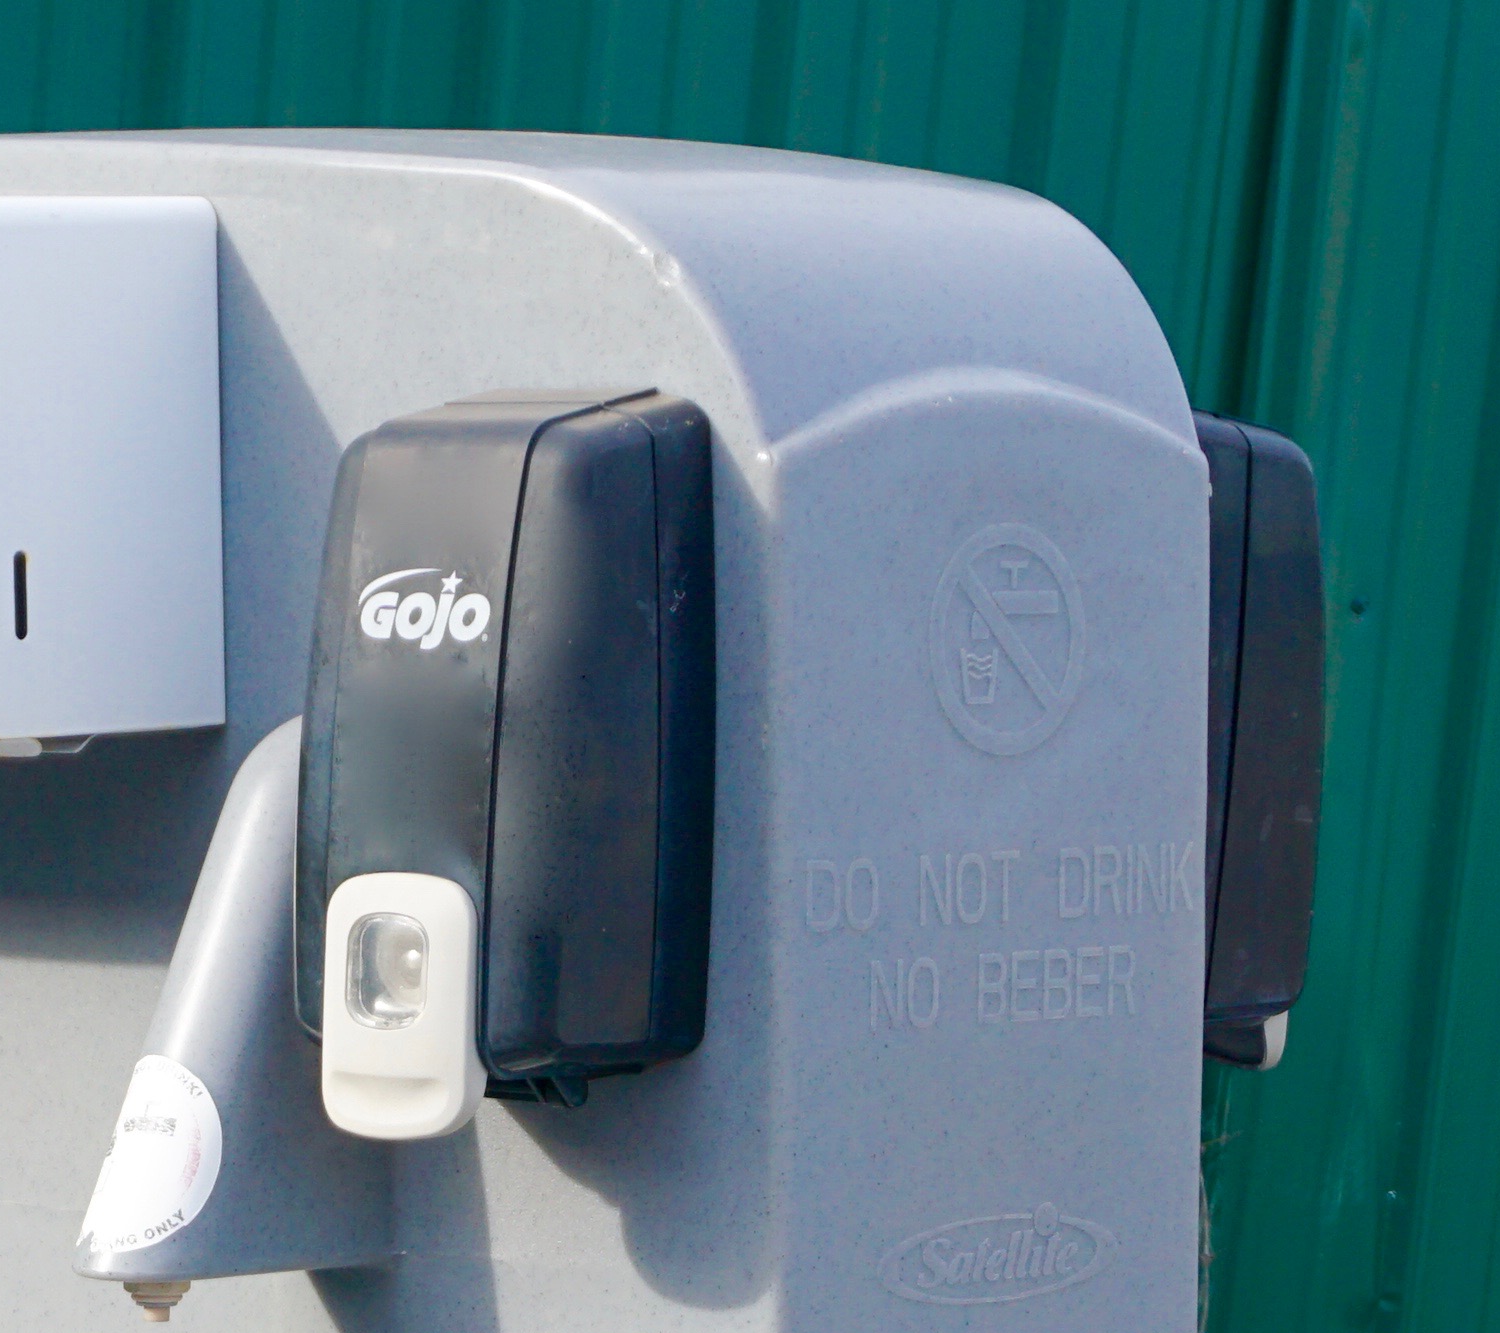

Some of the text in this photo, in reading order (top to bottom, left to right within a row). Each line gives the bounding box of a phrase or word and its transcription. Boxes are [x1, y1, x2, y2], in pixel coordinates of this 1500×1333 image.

[805, 840, 1196, 933] DO NOT DRINK
[869, 944, 1137, 1031] NO BEBER
[144, 1208, 185, 1239] ONLY
[916, 1227, 1080, 1288] Satellite
